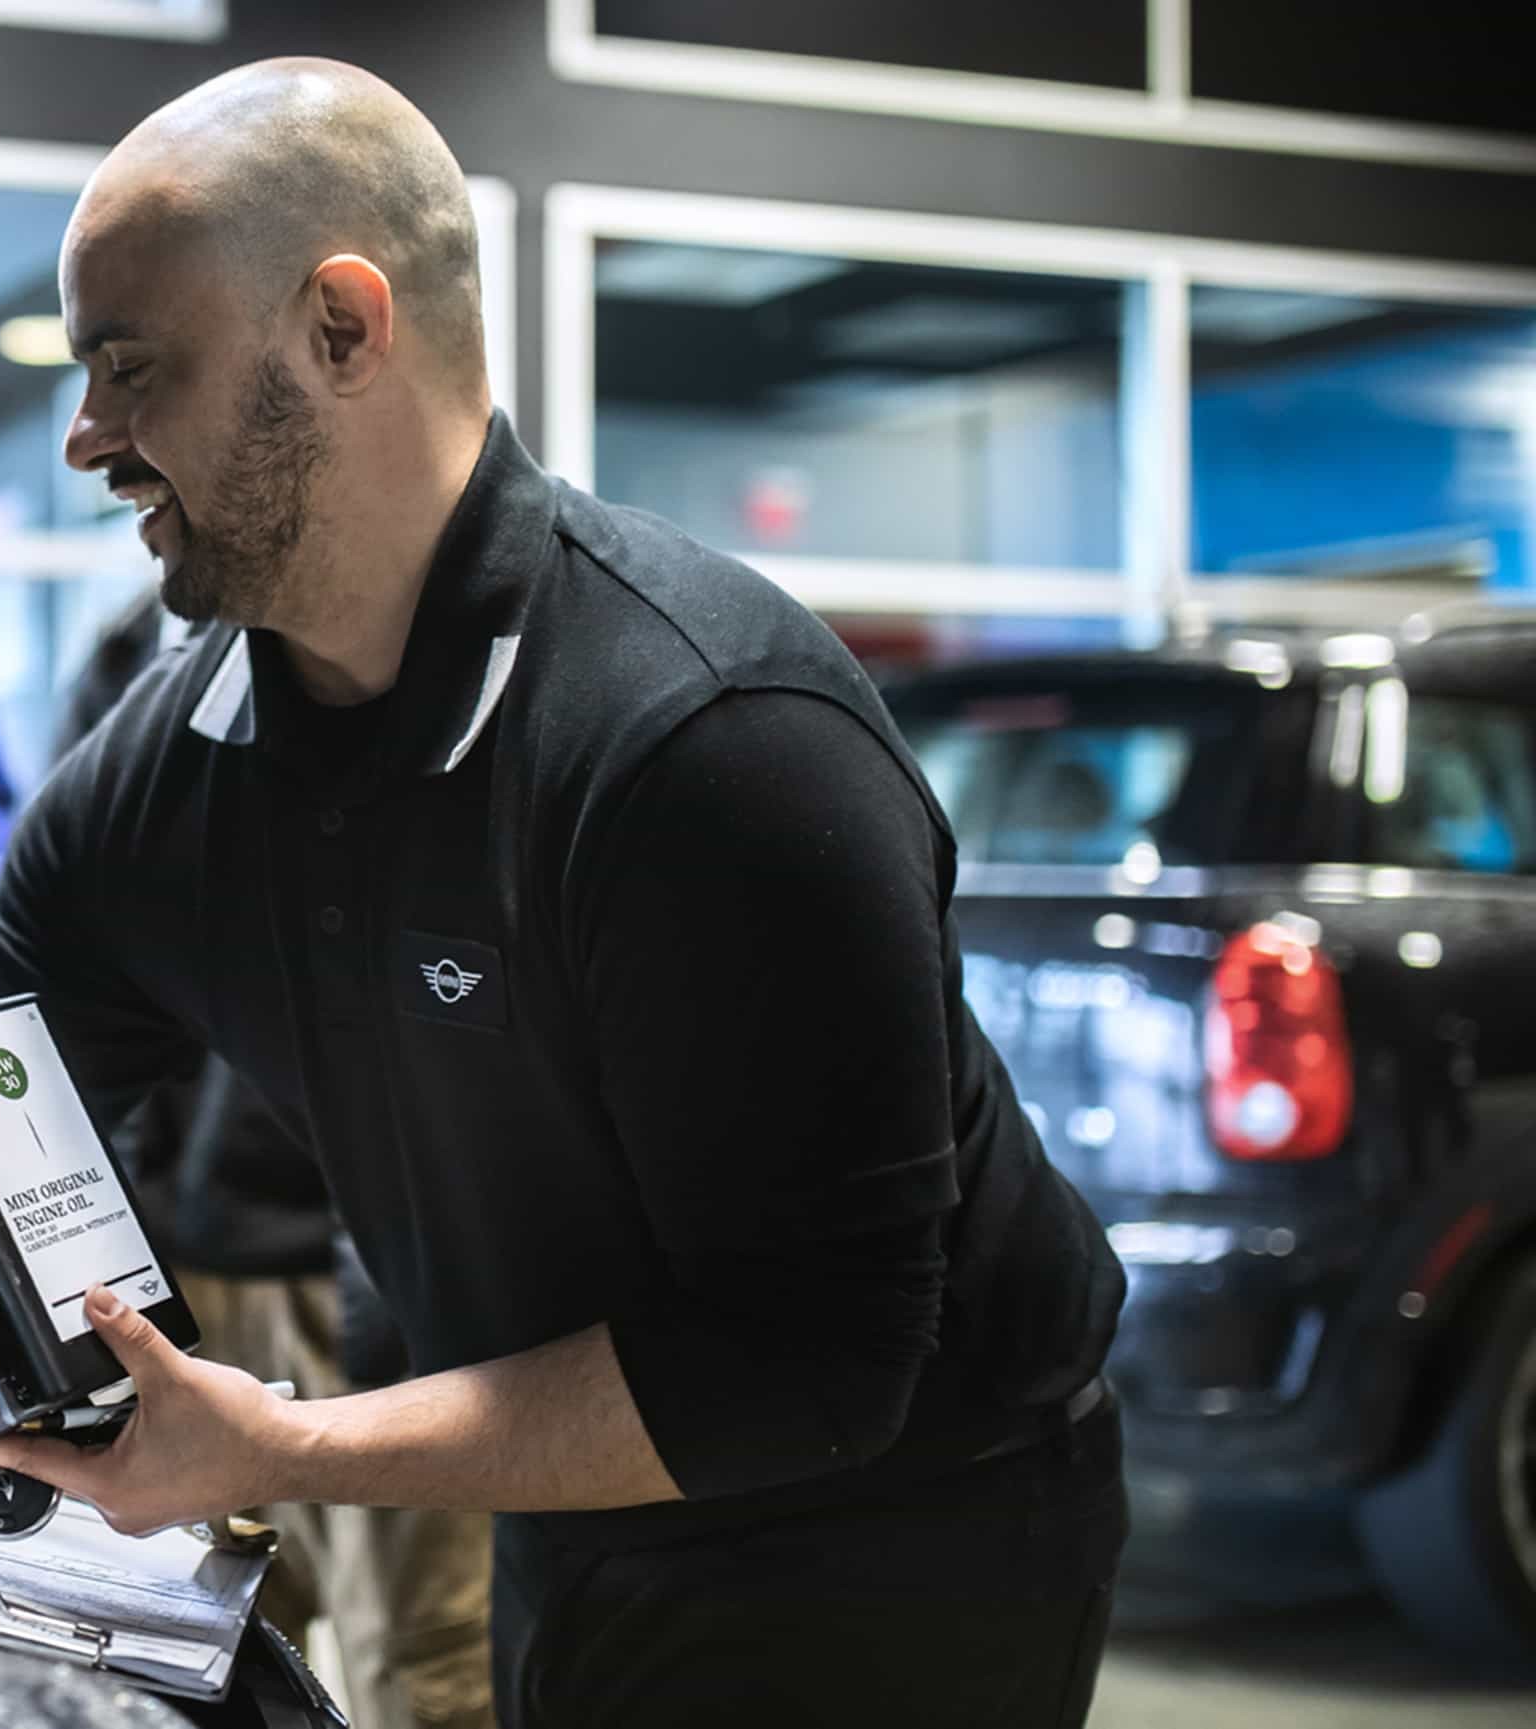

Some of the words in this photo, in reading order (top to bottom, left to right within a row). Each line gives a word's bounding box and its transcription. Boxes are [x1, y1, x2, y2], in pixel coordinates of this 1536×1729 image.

[0, 1073, 21, 1092] 30
[3, 1187, 40, 1213] MINI
[40, 1167, 104, 1200] ORIGINAL
[13, 1201, 67, 1233] ENGINE
